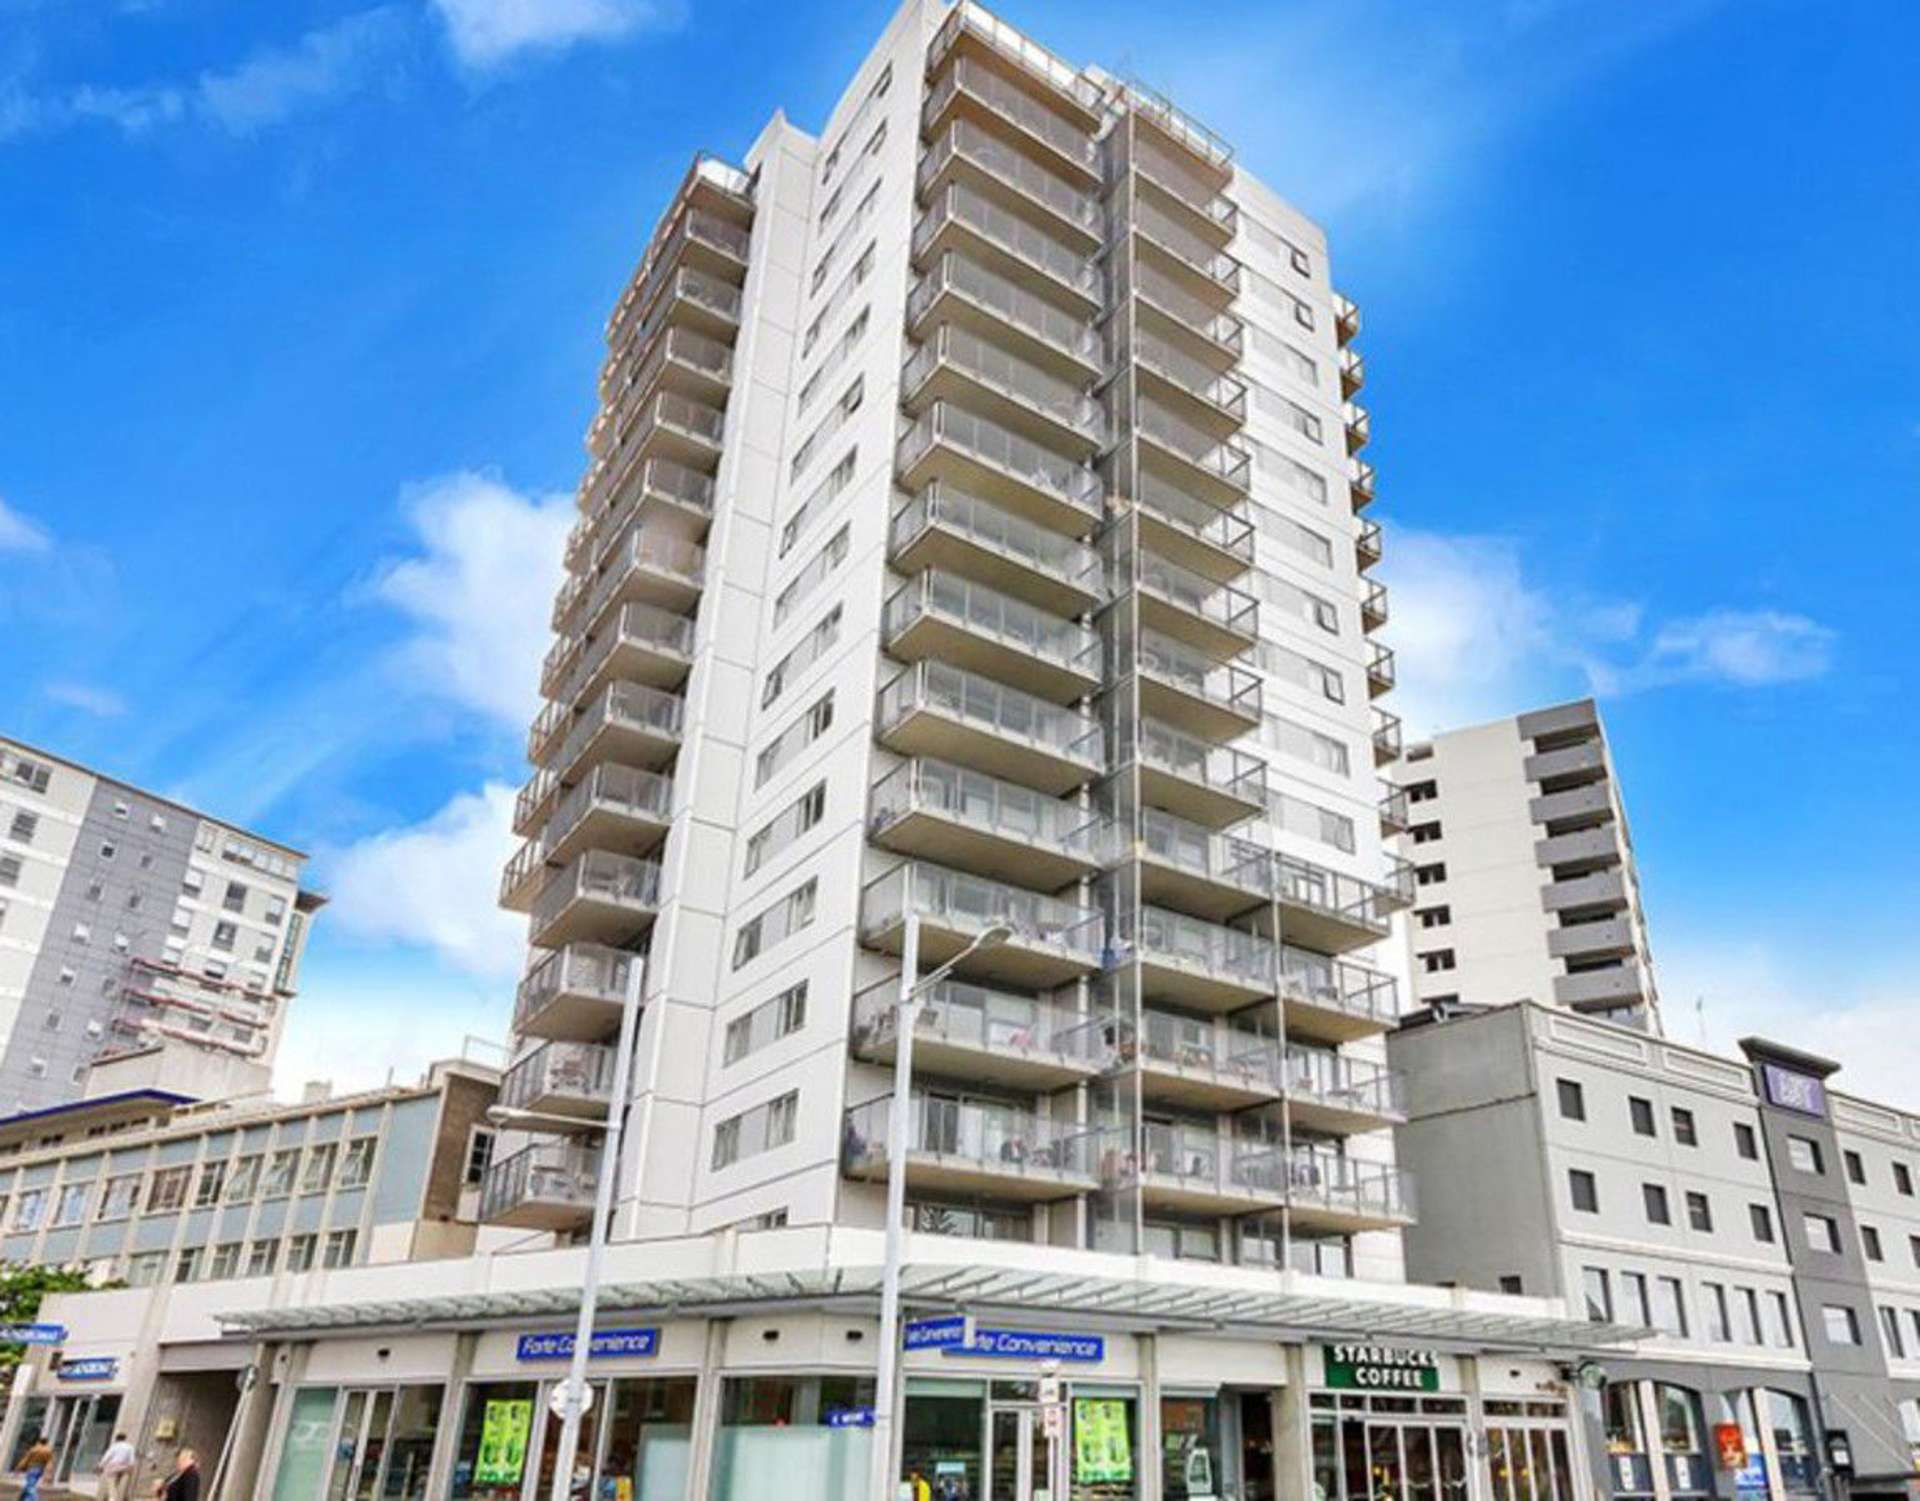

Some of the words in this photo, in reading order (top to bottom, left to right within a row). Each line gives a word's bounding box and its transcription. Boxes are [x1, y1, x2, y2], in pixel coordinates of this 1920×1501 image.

[997, 1334, 1099, 1356] Convenience
[1334, 1344, 1440, 1367] STARBUCKS
[1356, 1367, 1423, 1387] COFFEE
